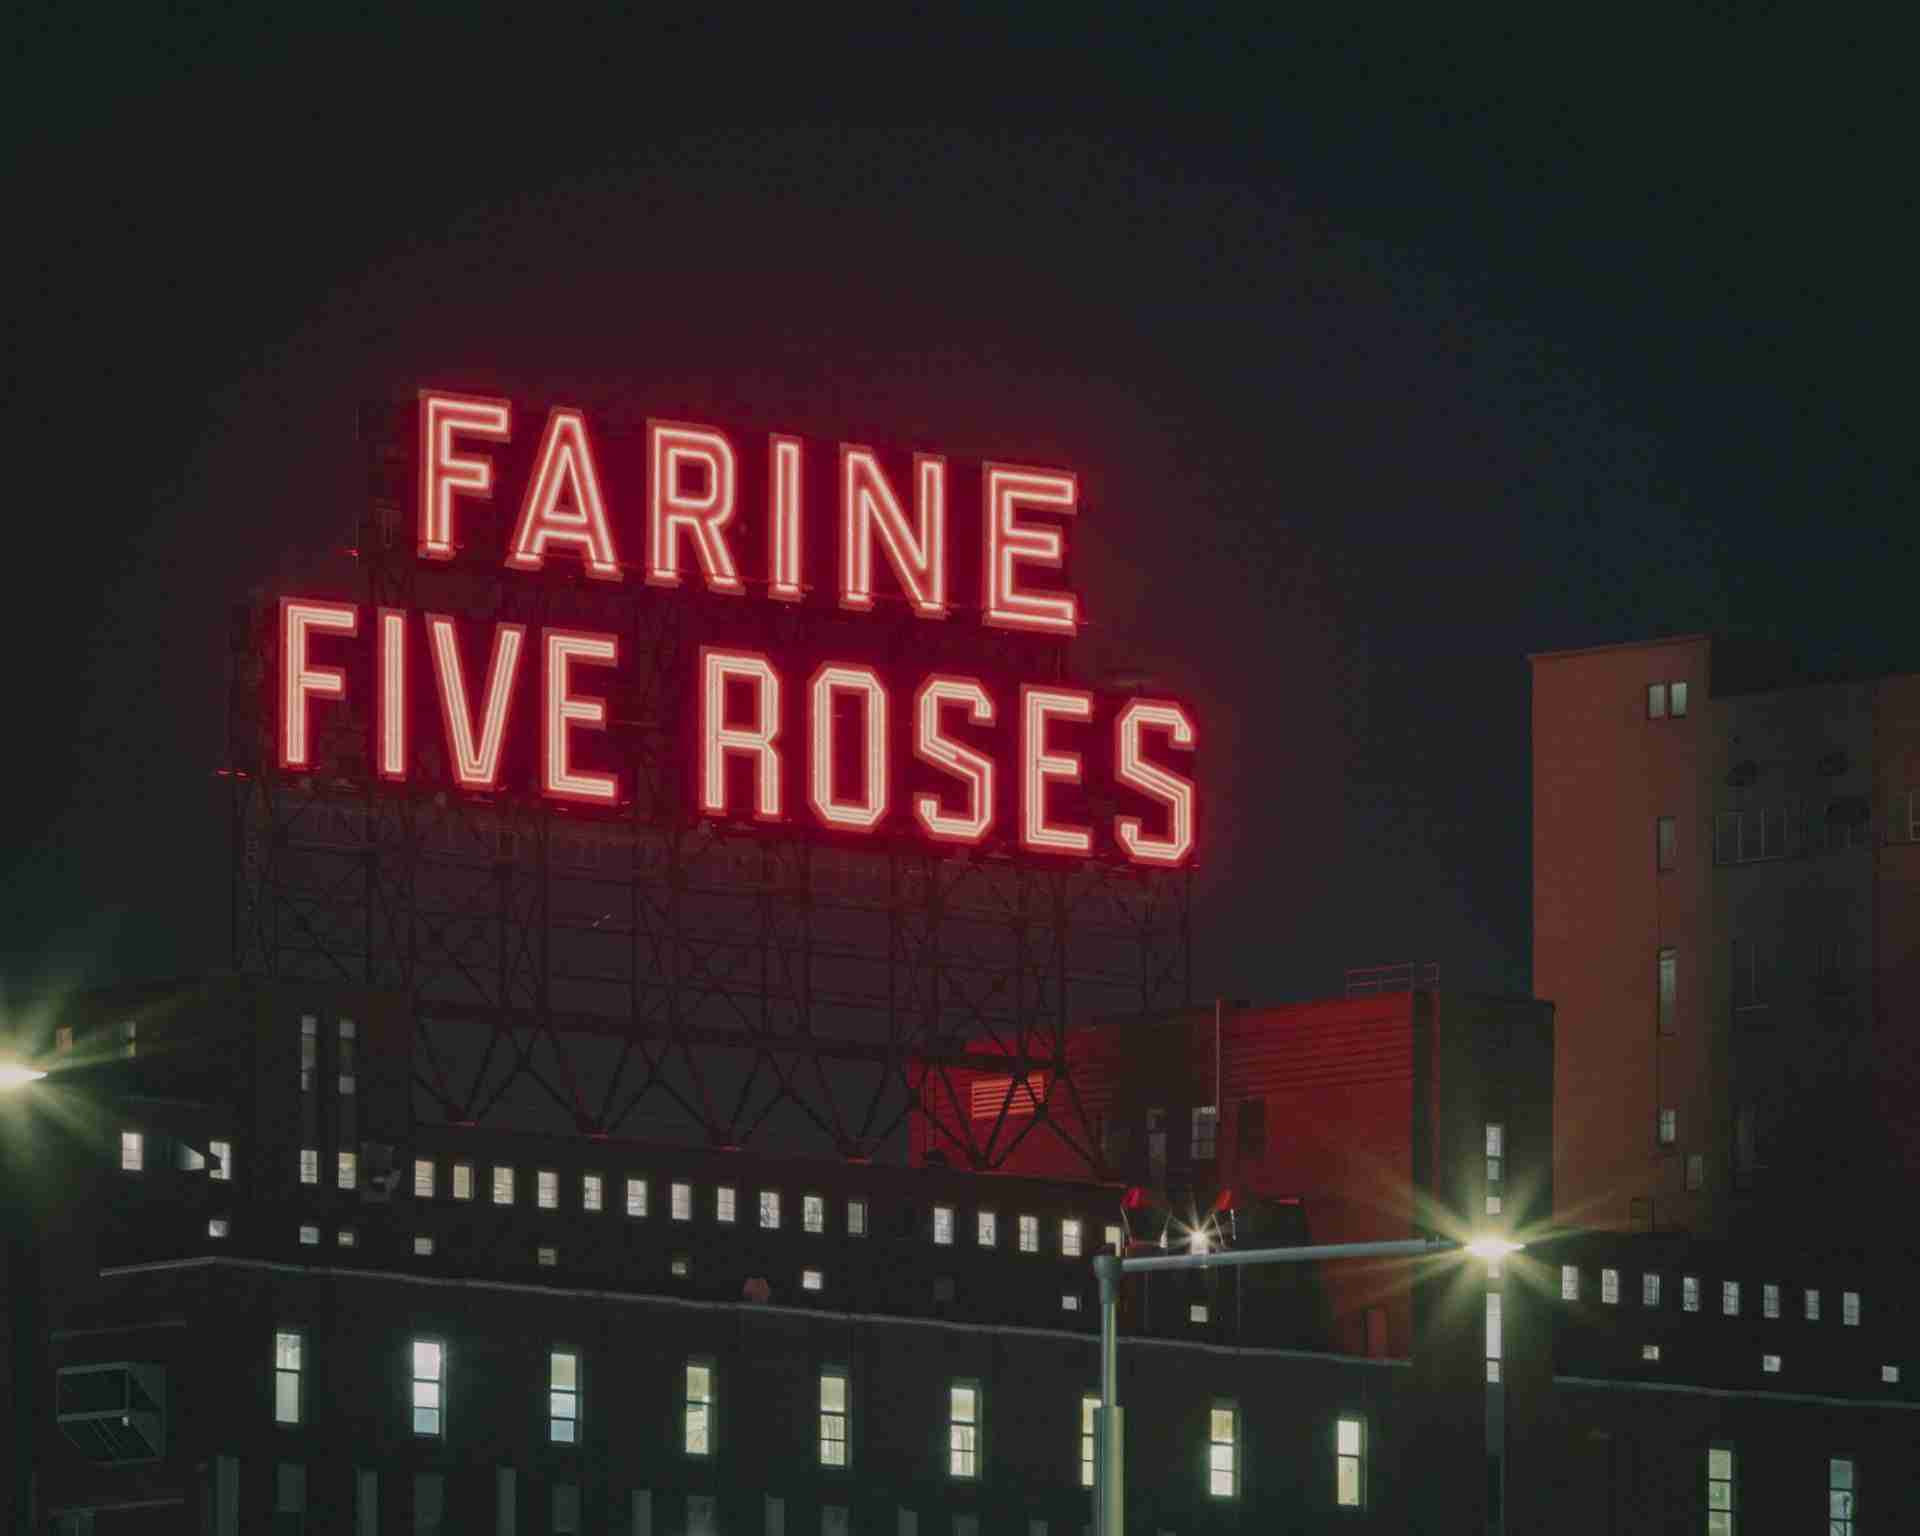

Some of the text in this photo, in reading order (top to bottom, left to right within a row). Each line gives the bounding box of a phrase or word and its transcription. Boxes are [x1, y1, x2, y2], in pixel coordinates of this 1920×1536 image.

[420, 390, 1076, 632] FARINE
[279, 599, 1196, 865] FIVE ROSES
